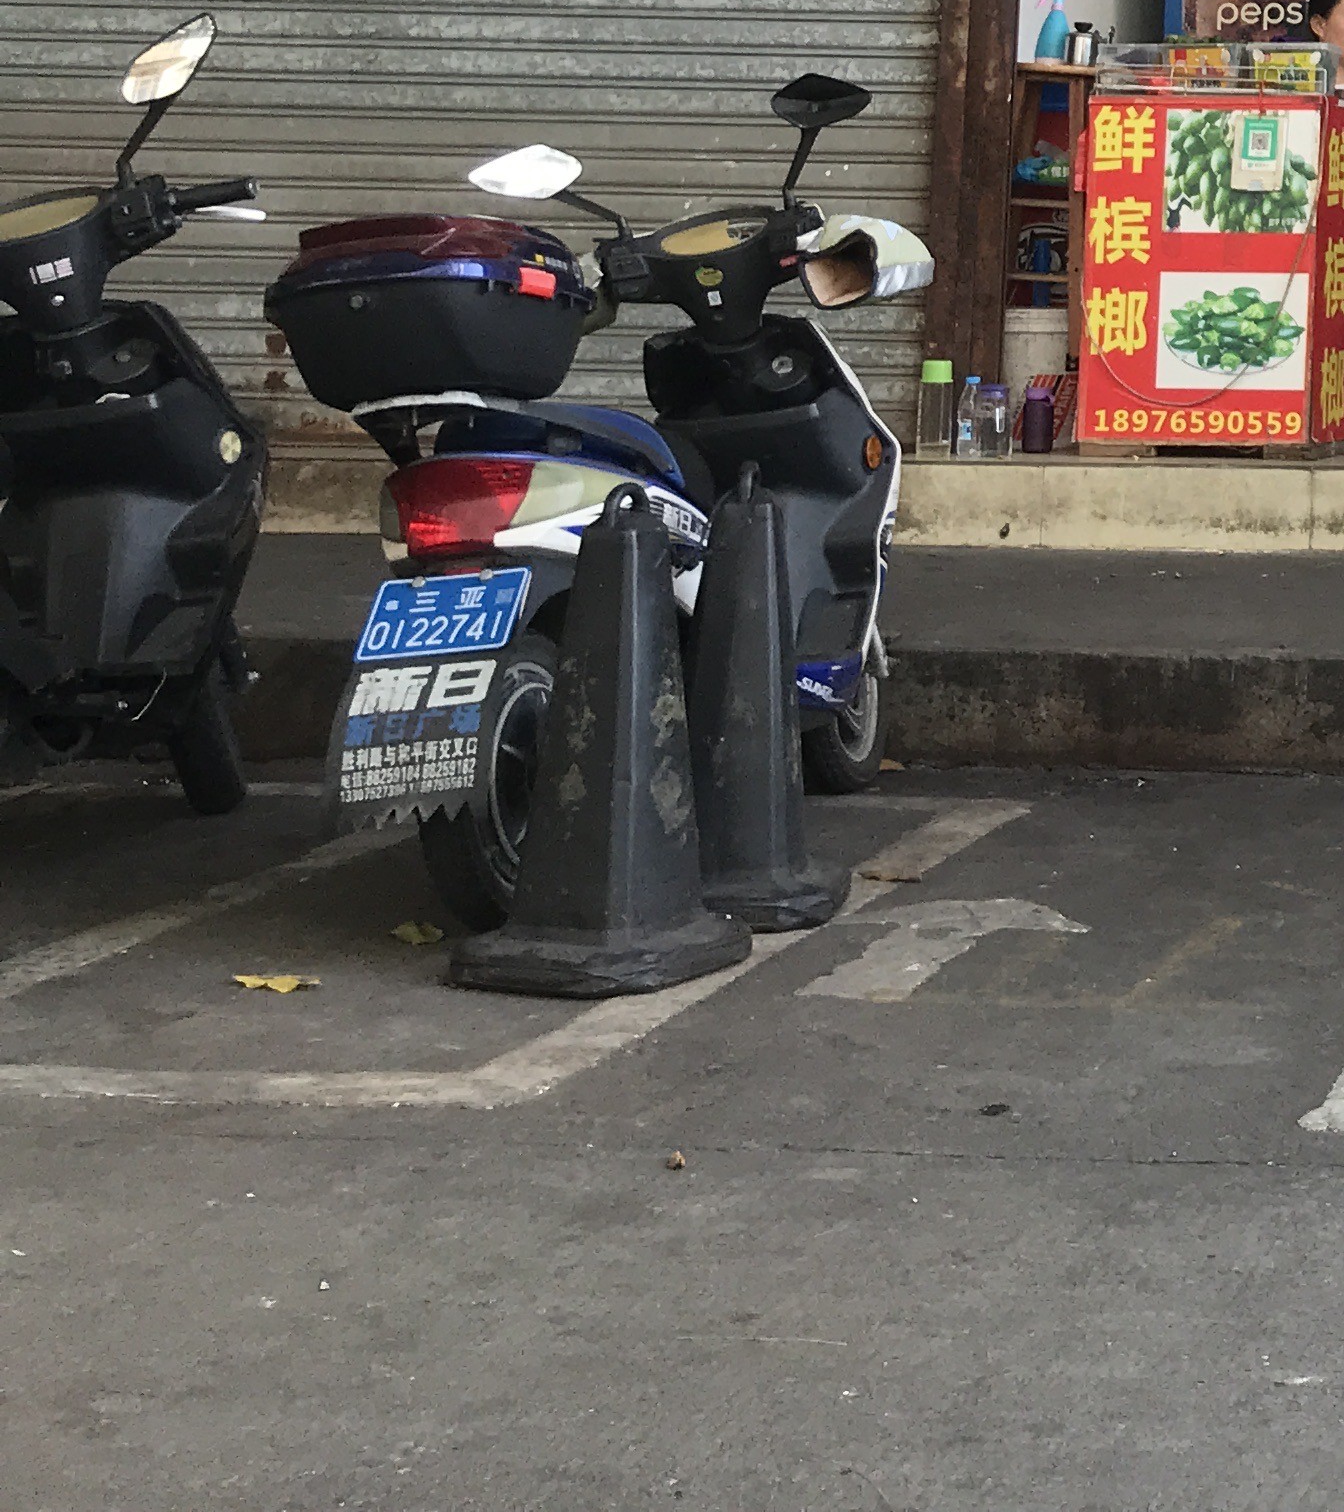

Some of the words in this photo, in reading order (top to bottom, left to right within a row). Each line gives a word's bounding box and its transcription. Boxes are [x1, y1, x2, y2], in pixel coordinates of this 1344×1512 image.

[1216, 0, 1308, 30] peps
[1086, 105, 1156, 356] 鲜槟榔
[1094, 409, 1302, 436] 18976590559
[367, 610, 503, 650] 0122741
[348, 659, 497, 717] 新日
